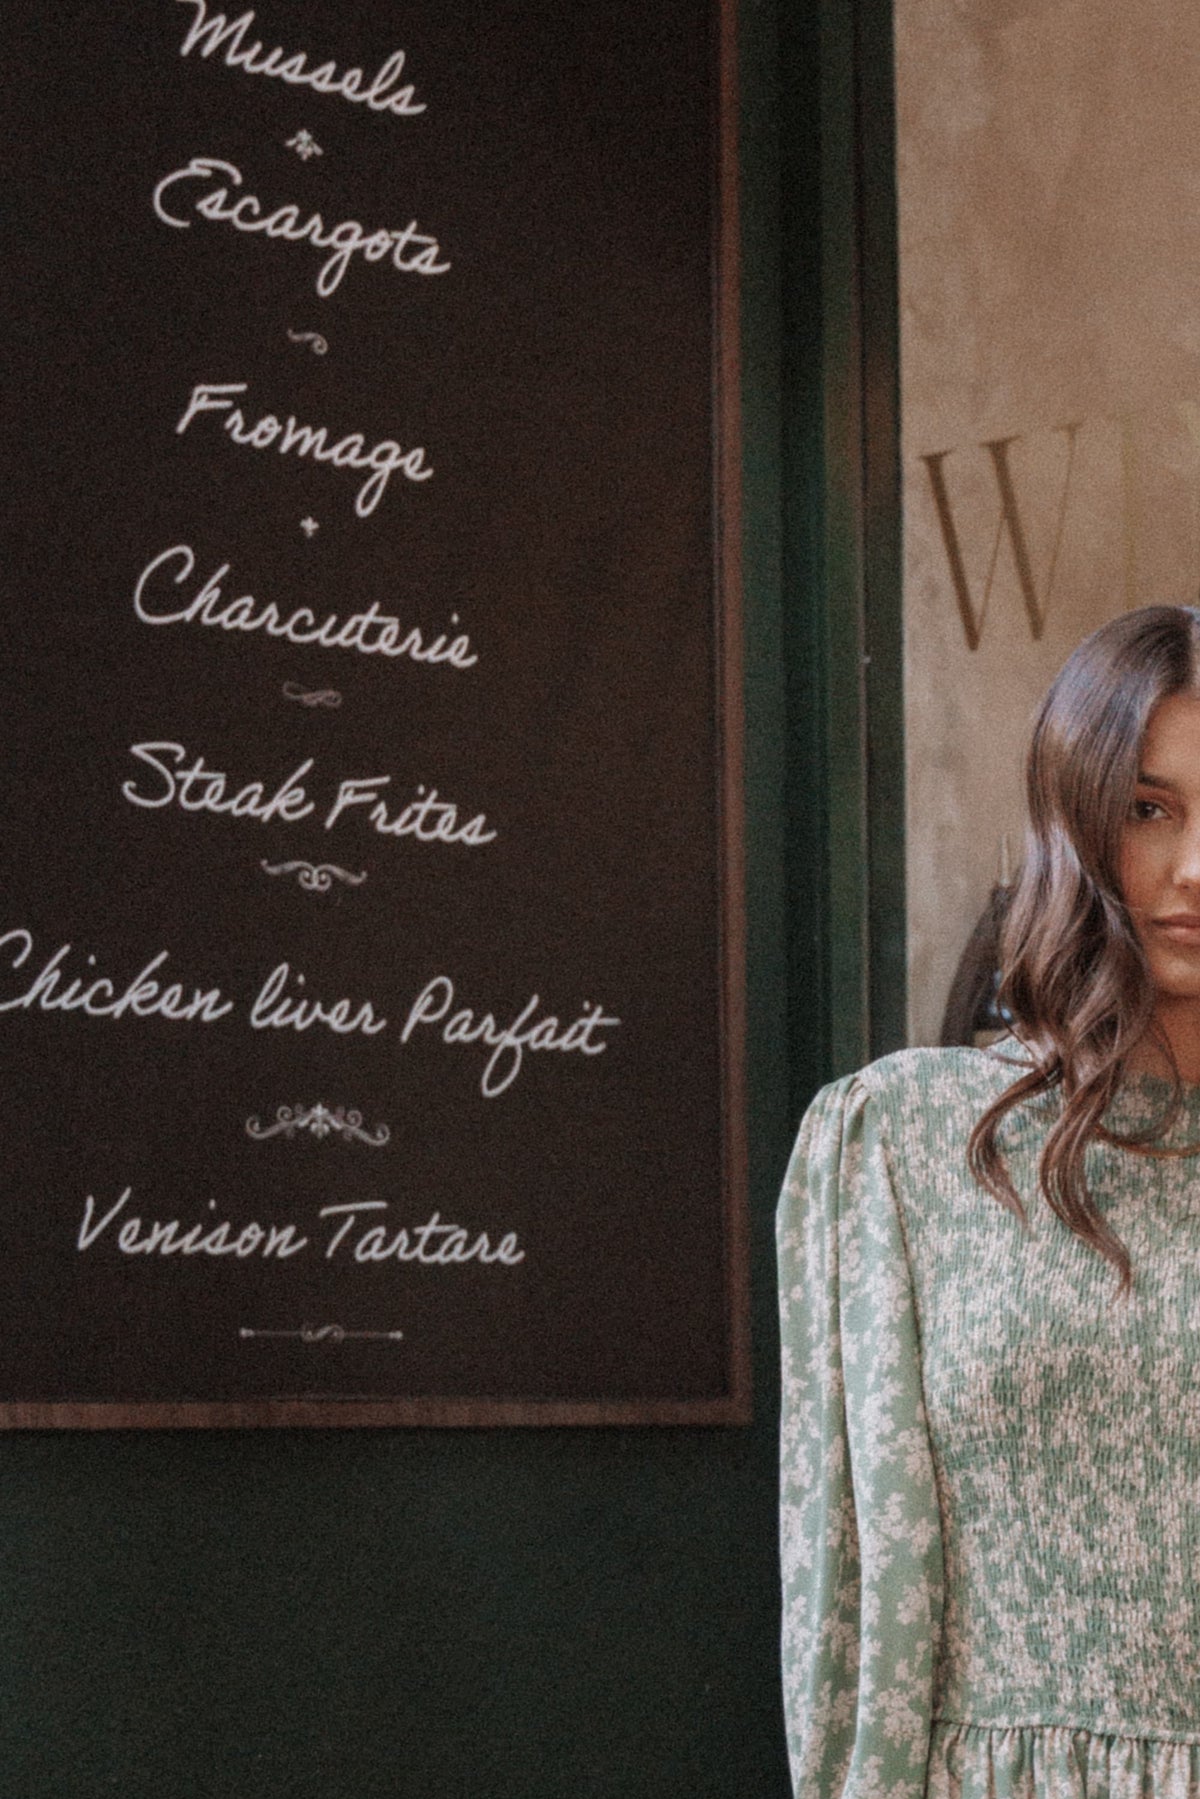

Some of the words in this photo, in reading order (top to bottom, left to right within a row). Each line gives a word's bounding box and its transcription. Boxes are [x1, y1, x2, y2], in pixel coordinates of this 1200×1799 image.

[178, 0, 427, 115] Mussels
[152, 158, 450, 297] Escargots
[176, 383, 433, 518] Fromage
[134, 545, 478, 668] Charcuterie
[122, 741, 315, 816] Steak
[324, 775, 498, 846] Frites
[0, 928, 233, 1022] Chicken
[249, 962, 387, 1035] liver
[400, 975, 621, 1098] Parfait
[76, 1187, 308, 1258] Venison
[319, 1200, 525, 1265] Tartare
